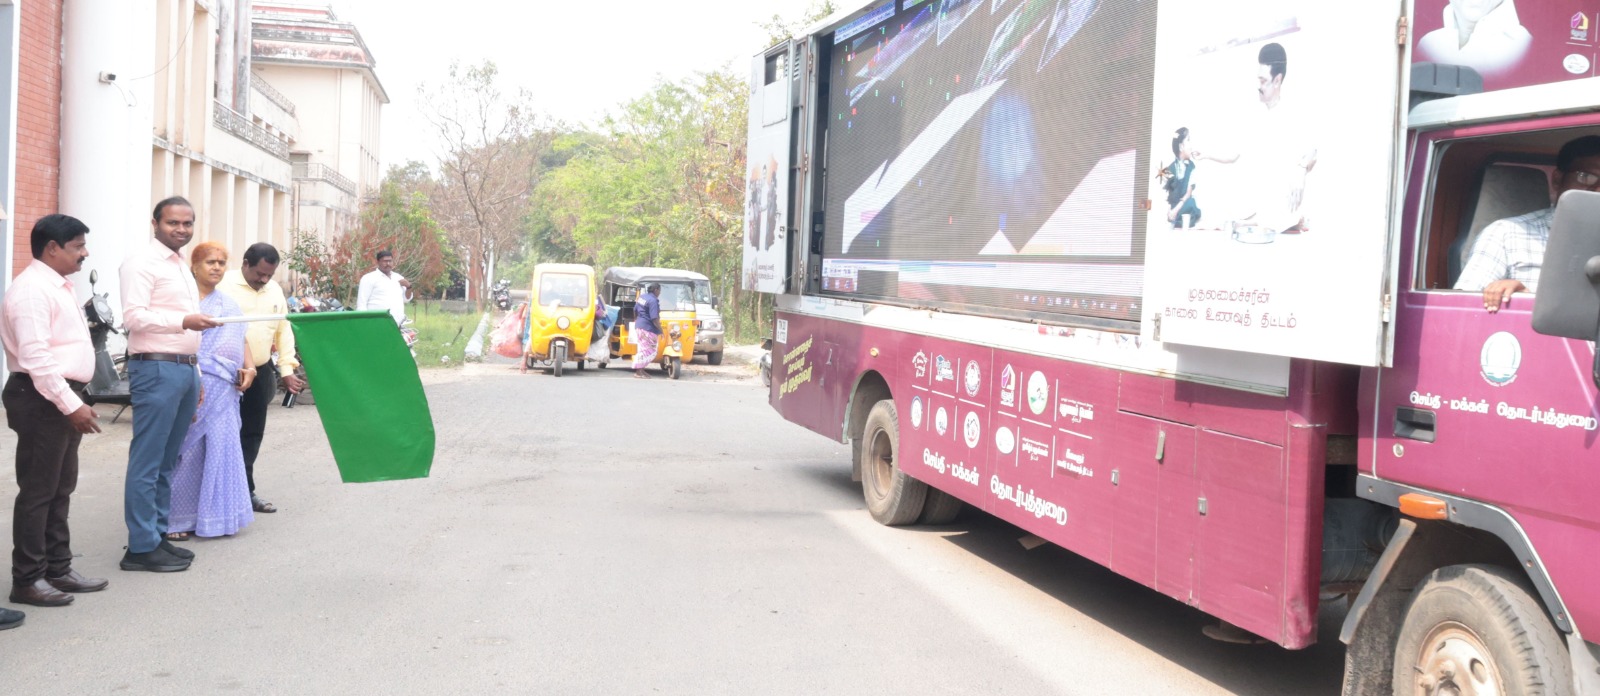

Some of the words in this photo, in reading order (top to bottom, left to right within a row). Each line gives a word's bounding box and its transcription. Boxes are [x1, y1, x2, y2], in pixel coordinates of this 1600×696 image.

[1188, 287, 1270, 305] முதலமைச்சரின்
[1164, 307, 1198, 319] காலை
[1205, 307, 1252, 327] உணவுத்
[1260, 312, 1297, 328] திட்டம்
[1409, 391, 1441, 409] செய்தி
[1450, 397, 1490, 414] மக்கள்
[1496, 402, 1598, 430] தொடர்புத்துறை
[923, 448, 945, 474] செய்தி
[952, 461, 979, 486] மக்கள்
[990, 474, 1068, 526] தொடர்புத்துறை
